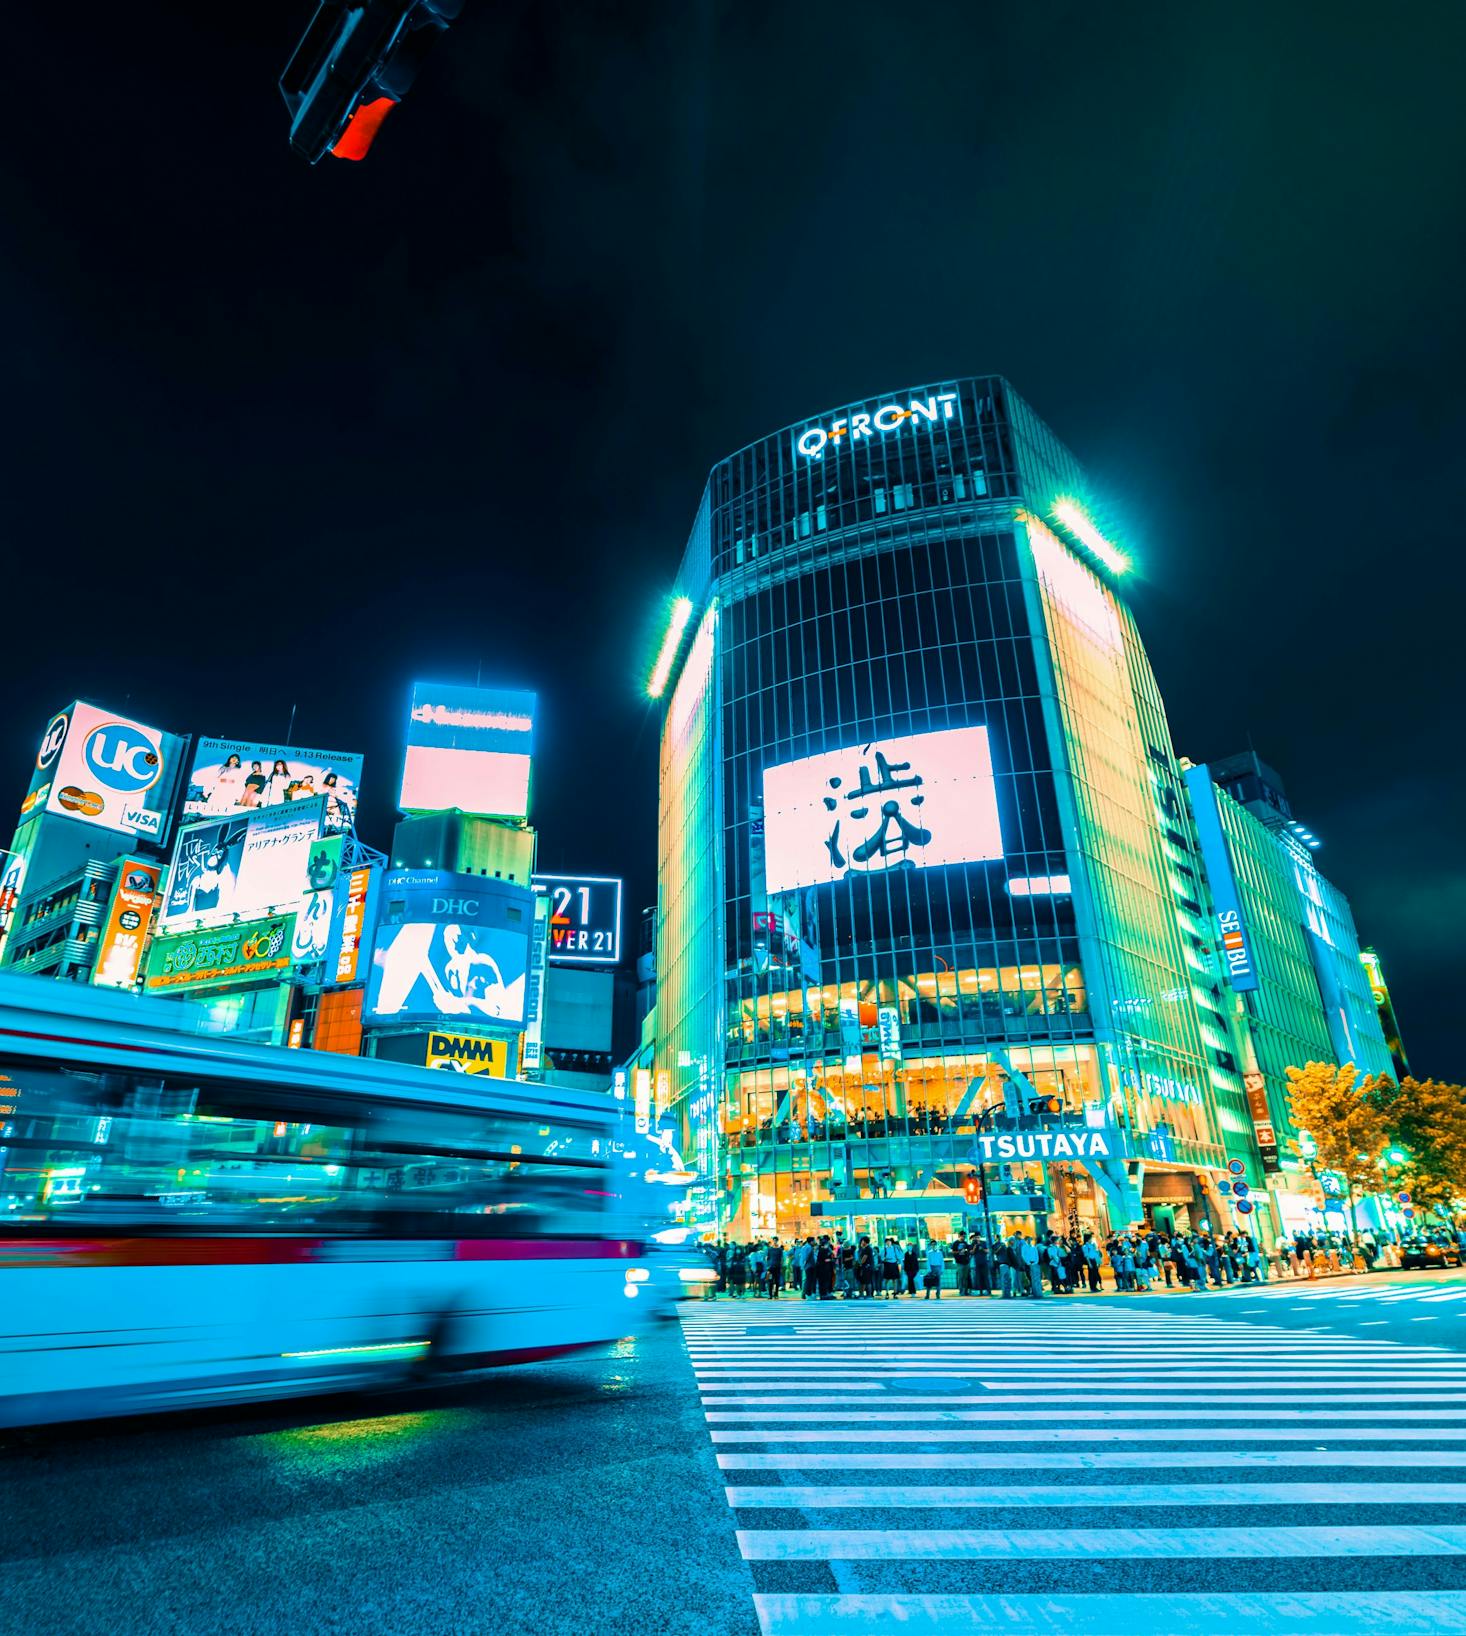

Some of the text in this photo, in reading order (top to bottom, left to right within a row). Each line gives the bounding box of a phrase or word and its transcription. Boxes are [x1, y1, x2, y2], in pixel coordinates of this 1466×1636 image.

[798, 393, 957, 458] QFRONT
[92, 733, 155, 780] UC
[203, 740, 219, 749] 9th
[221, 742, 250, 752] Single
[316, 753, 353, 763] Release
[127, 811, 158, 828] VISA
[248, 829, 316, 851] アリアナ・グランデ
[406, 876, 439, 884] Channel
[431, 898, 480, 916] DHC
[531, 885, 590, 925] 21
[548, 929, 613, 951] VER 21
[527, 973, 542, 1022] neon
[431, 1035, 493, 1062] DMM
[1146, 1073, 1202, 1106] TSUTAYA
[979, 1132, 1110, 1158] TSUTAYA
